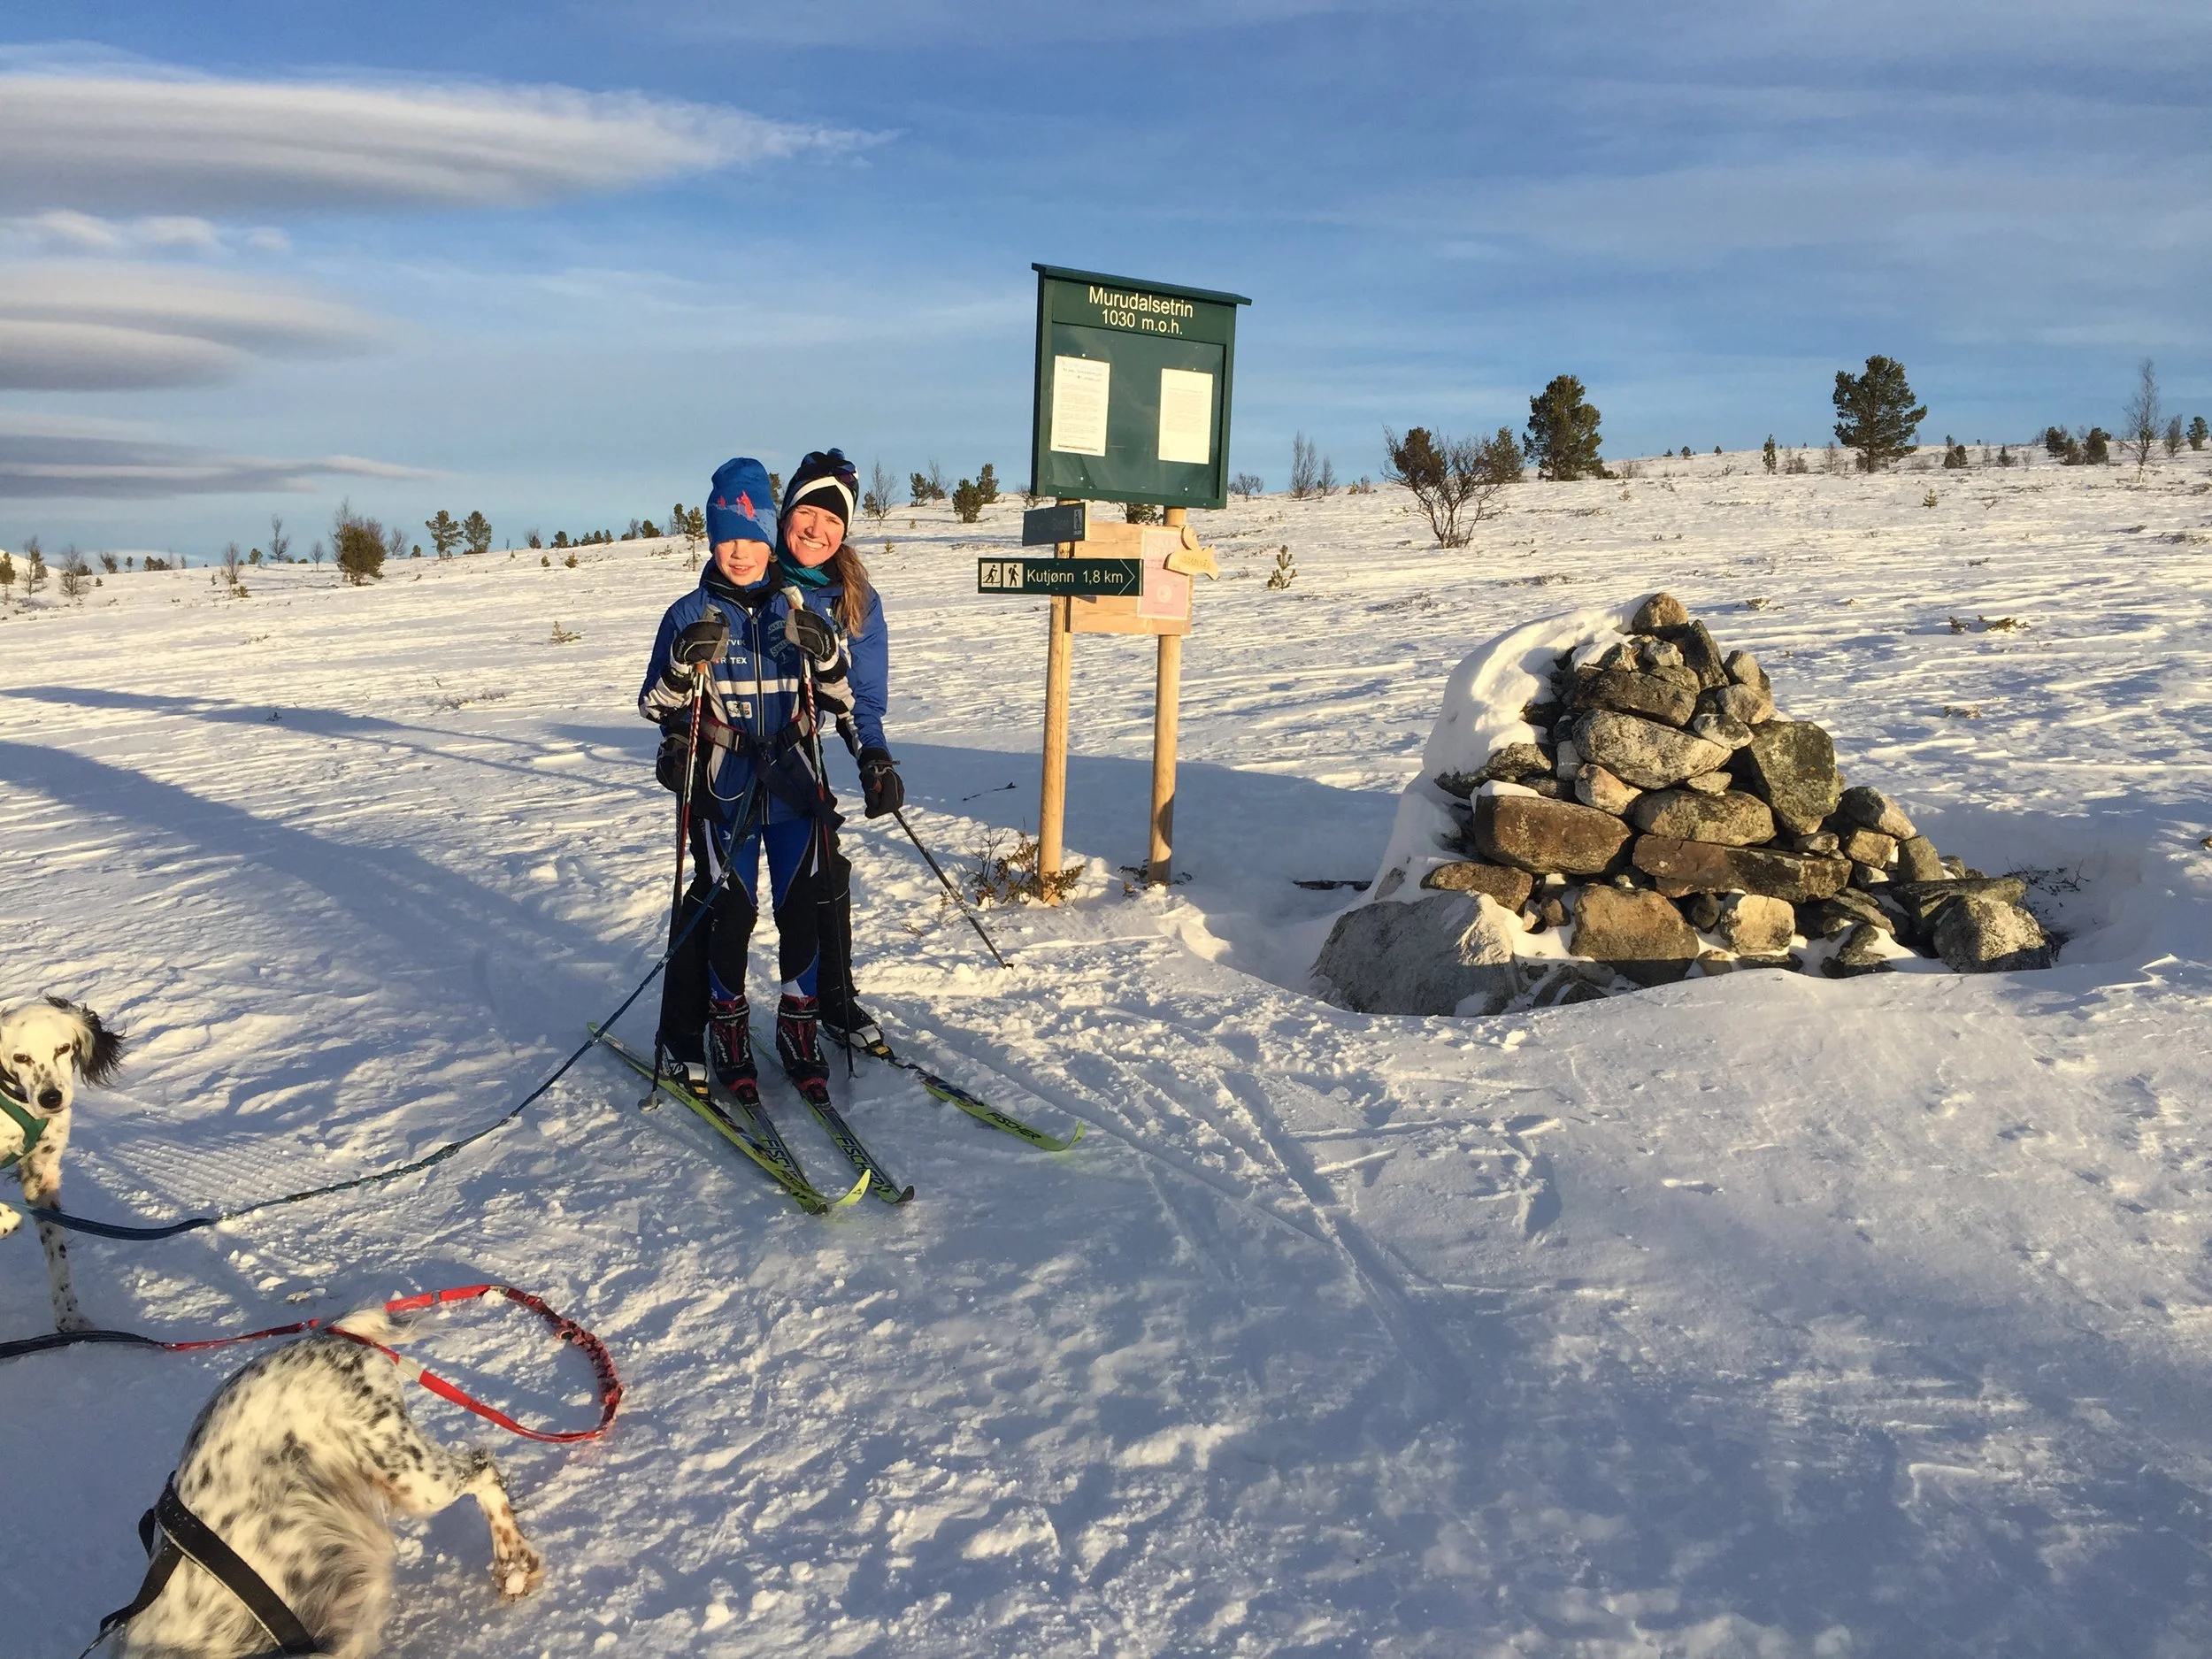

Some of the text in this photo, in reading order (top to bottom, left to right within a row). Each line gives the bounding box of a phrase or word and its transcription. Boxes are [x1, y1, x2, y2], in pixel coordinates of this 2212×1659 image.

[1089, 286, 1193, 318] Murudalsetrin
[1102, 309, 1183, 334] 1030 m.o.h.
[1026, 568, 1124, 586] Kutjønn 1,8 km
[985, 1112, 1041, 1140] FISCHER
